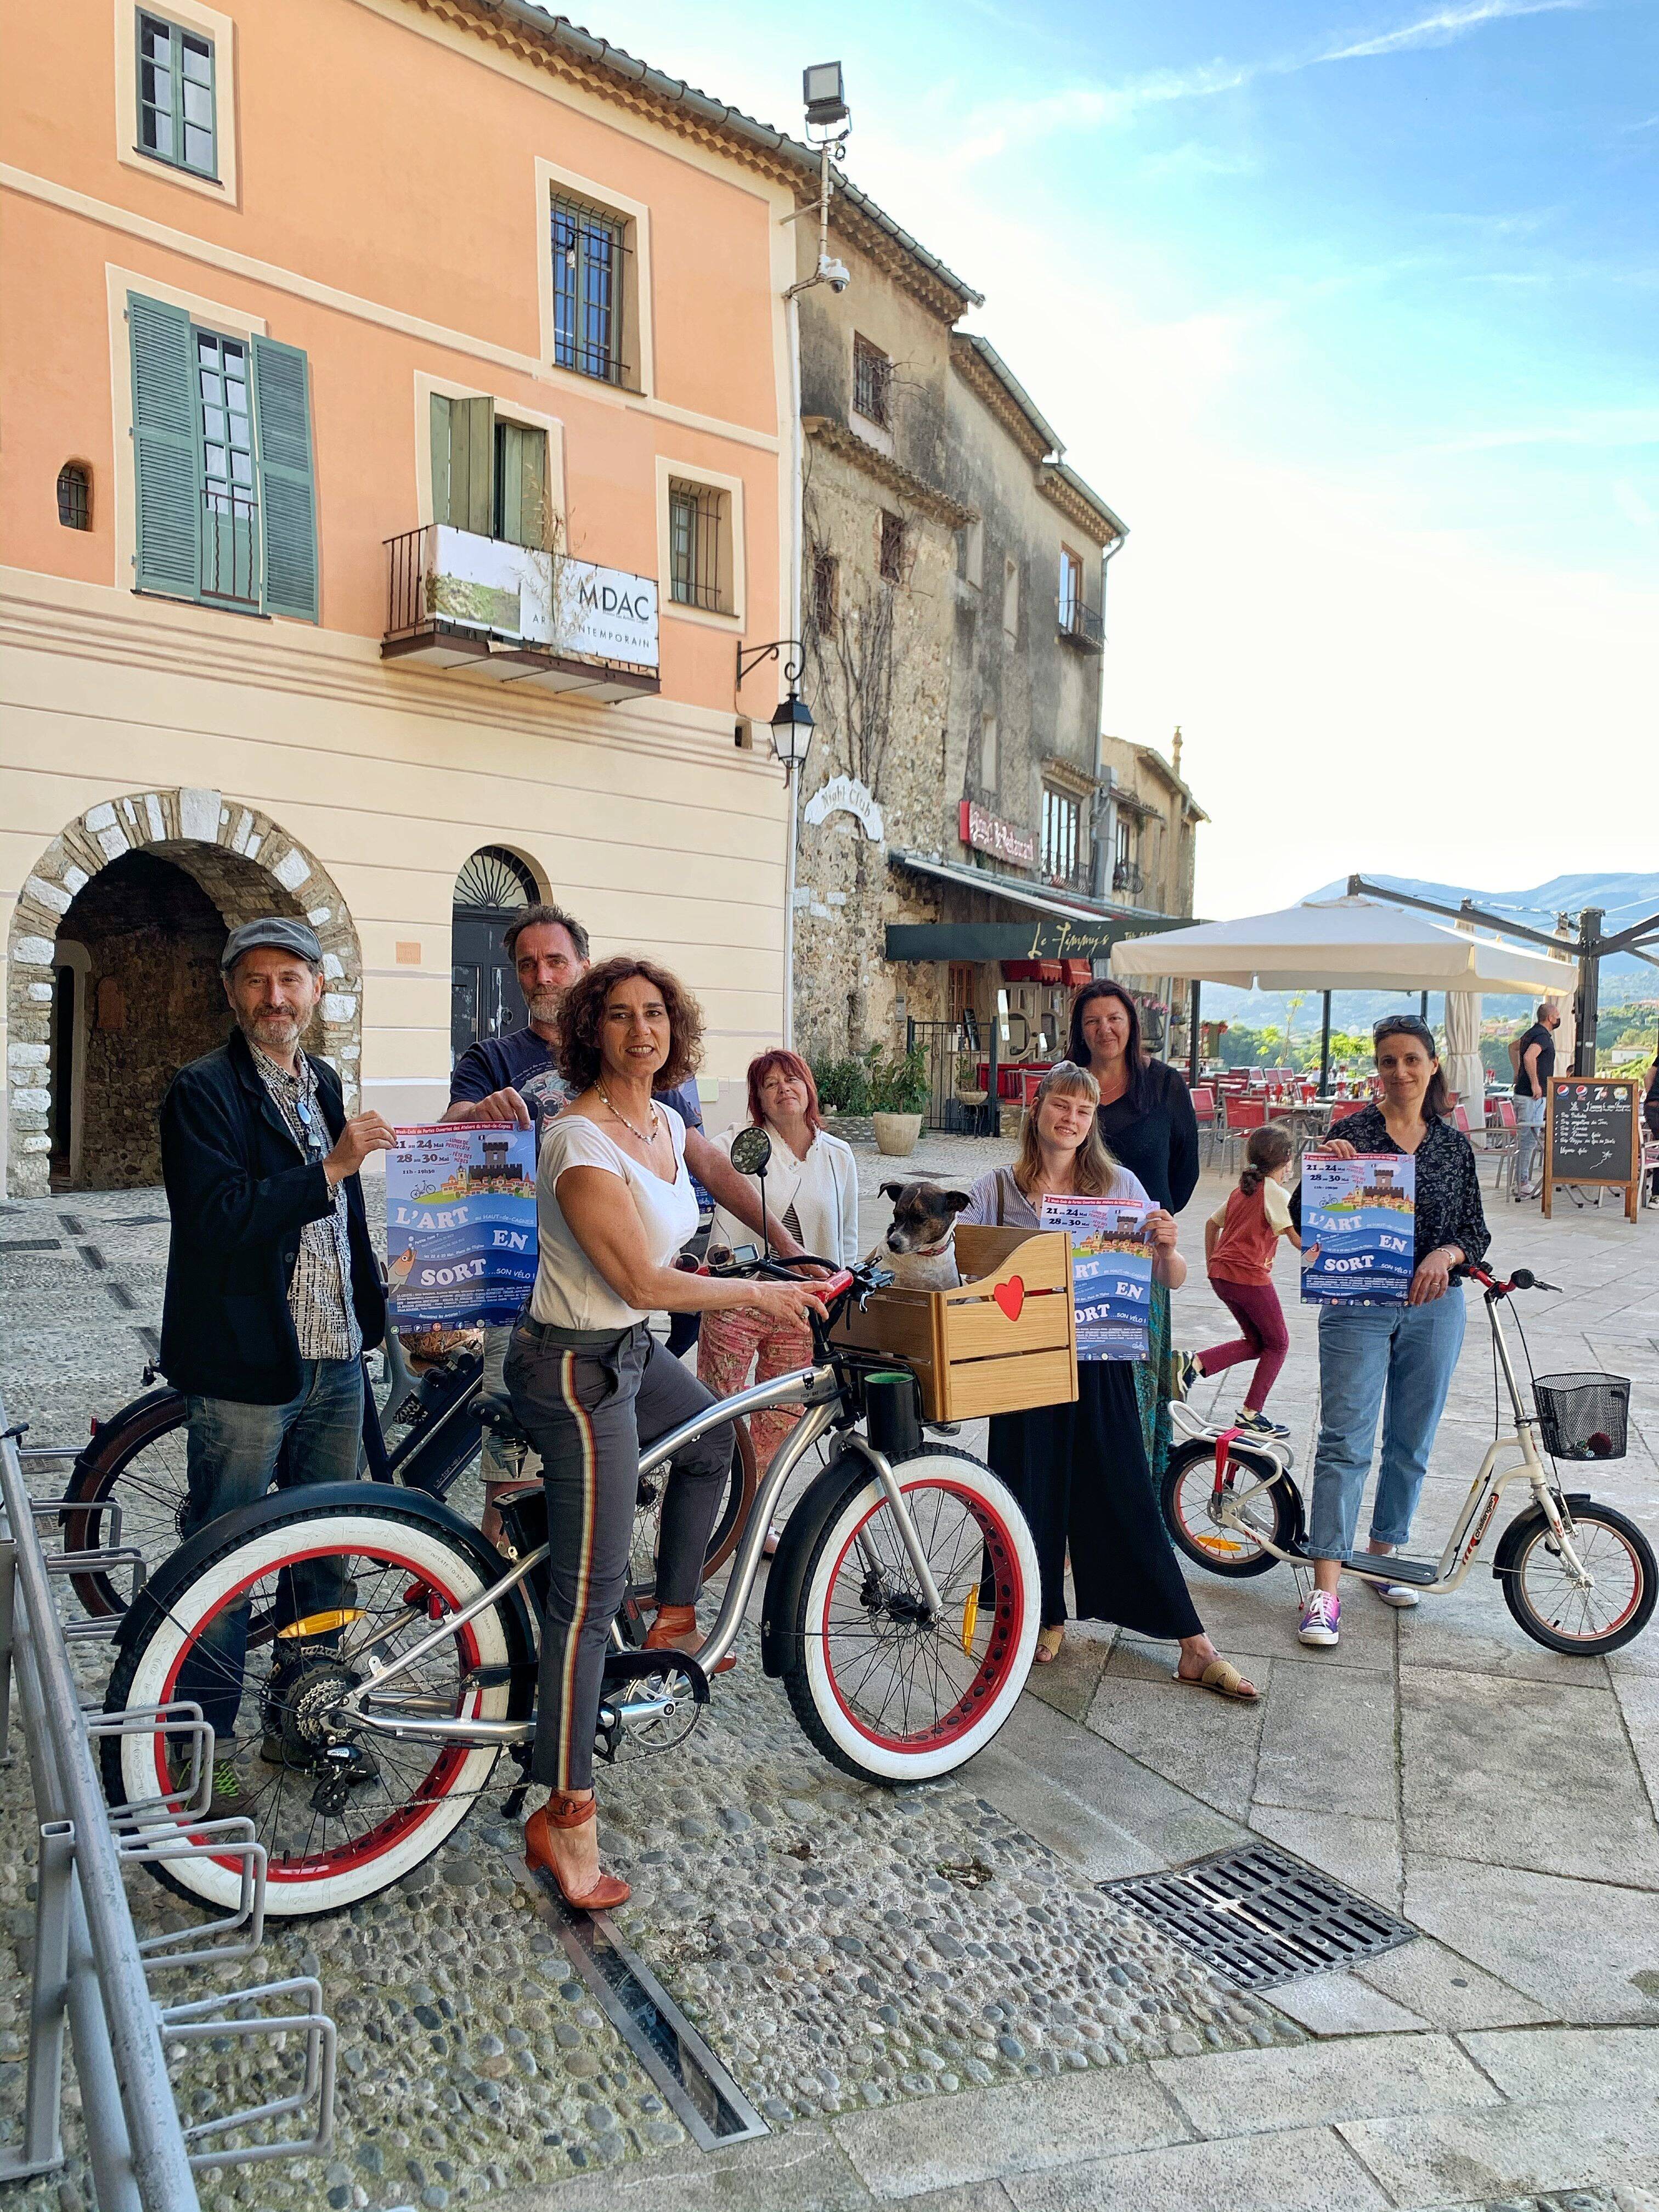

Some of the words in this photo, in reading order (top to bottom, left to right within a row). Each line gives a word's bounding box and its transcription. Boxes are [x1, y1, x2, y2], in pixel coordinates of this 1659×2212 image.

[579, 576, 649, 622] MDAC
[562, 621, 650, 648] CONTEMPORAIN
[849, 789, 870, 817] Club
[1028, 922, 1047, 960] Le
[394, 1141, 406, 1149] 21
[416, 1139, 432, 1149] 24
[397, 1154, 412, 1163] 28
[422, 1154, 437, 1163] 30
[395, 1206, 469, 1229] L'ART
[1307, 1212, 1362, 1231] L'ART
[492, 1229, 528, 1250] EN
[1379, 1234, 1407, 1252] EN
[420, 1258, 487, 1286] SORT
[514, 1269, 531, 1279] VÉLO
[1324, 1255, 1374, 1272] SORT
[1115, 1282, 1144, 1300] EN
[1074, 1304, 1110, 1323] ORT
[1130, 1315, 1143, 1323] VÉLO
[1475, 1497, 1494, 1538] challenger
[430, 1553, 448, 1568] INFLATE
